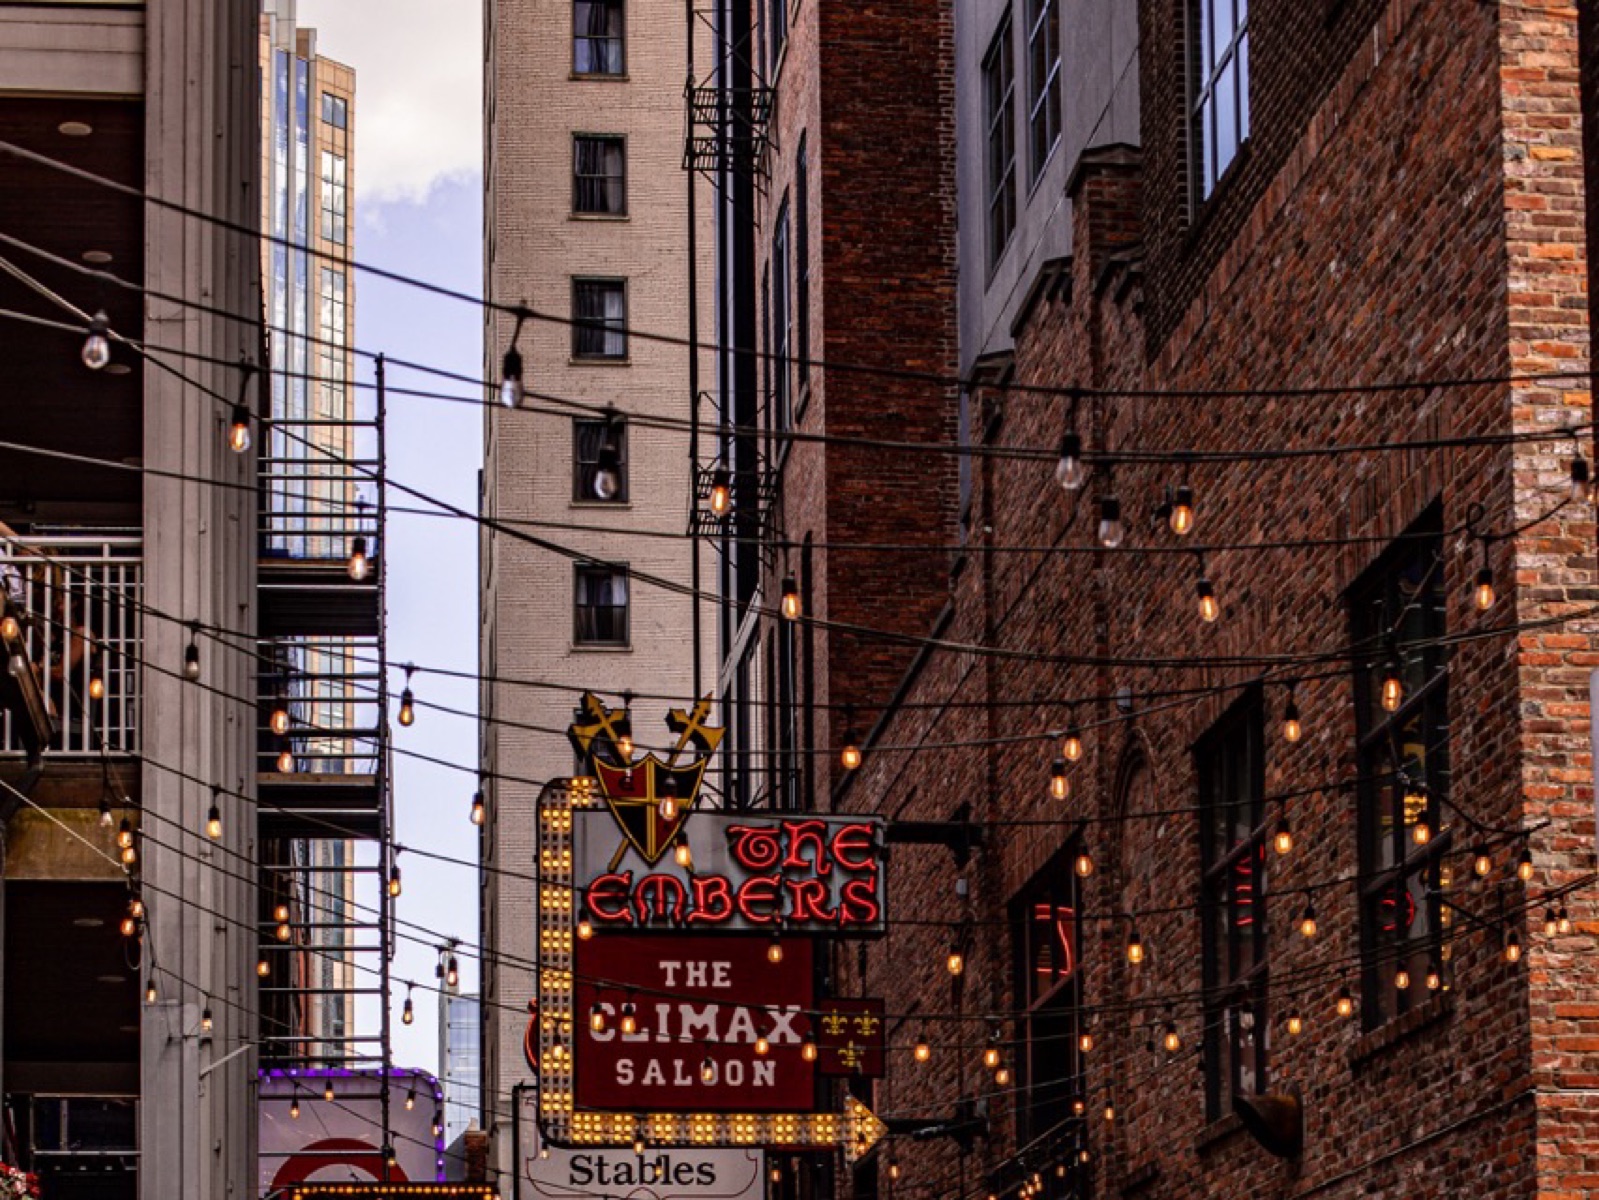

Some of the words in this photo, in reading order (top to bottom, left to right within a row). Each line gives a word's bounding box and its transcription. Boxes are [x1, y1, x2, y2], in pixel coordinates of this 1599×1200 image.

[727, 820, 879, 875] THE
[585, 870, 881, 927] EMBERS
[659, 960, 733, 988] THE
[589, 1003, 803, 1044] CLIMAX
[615, 1059, 778, 1087] SALOON
[568, 1153, 718, 1187] Stables
